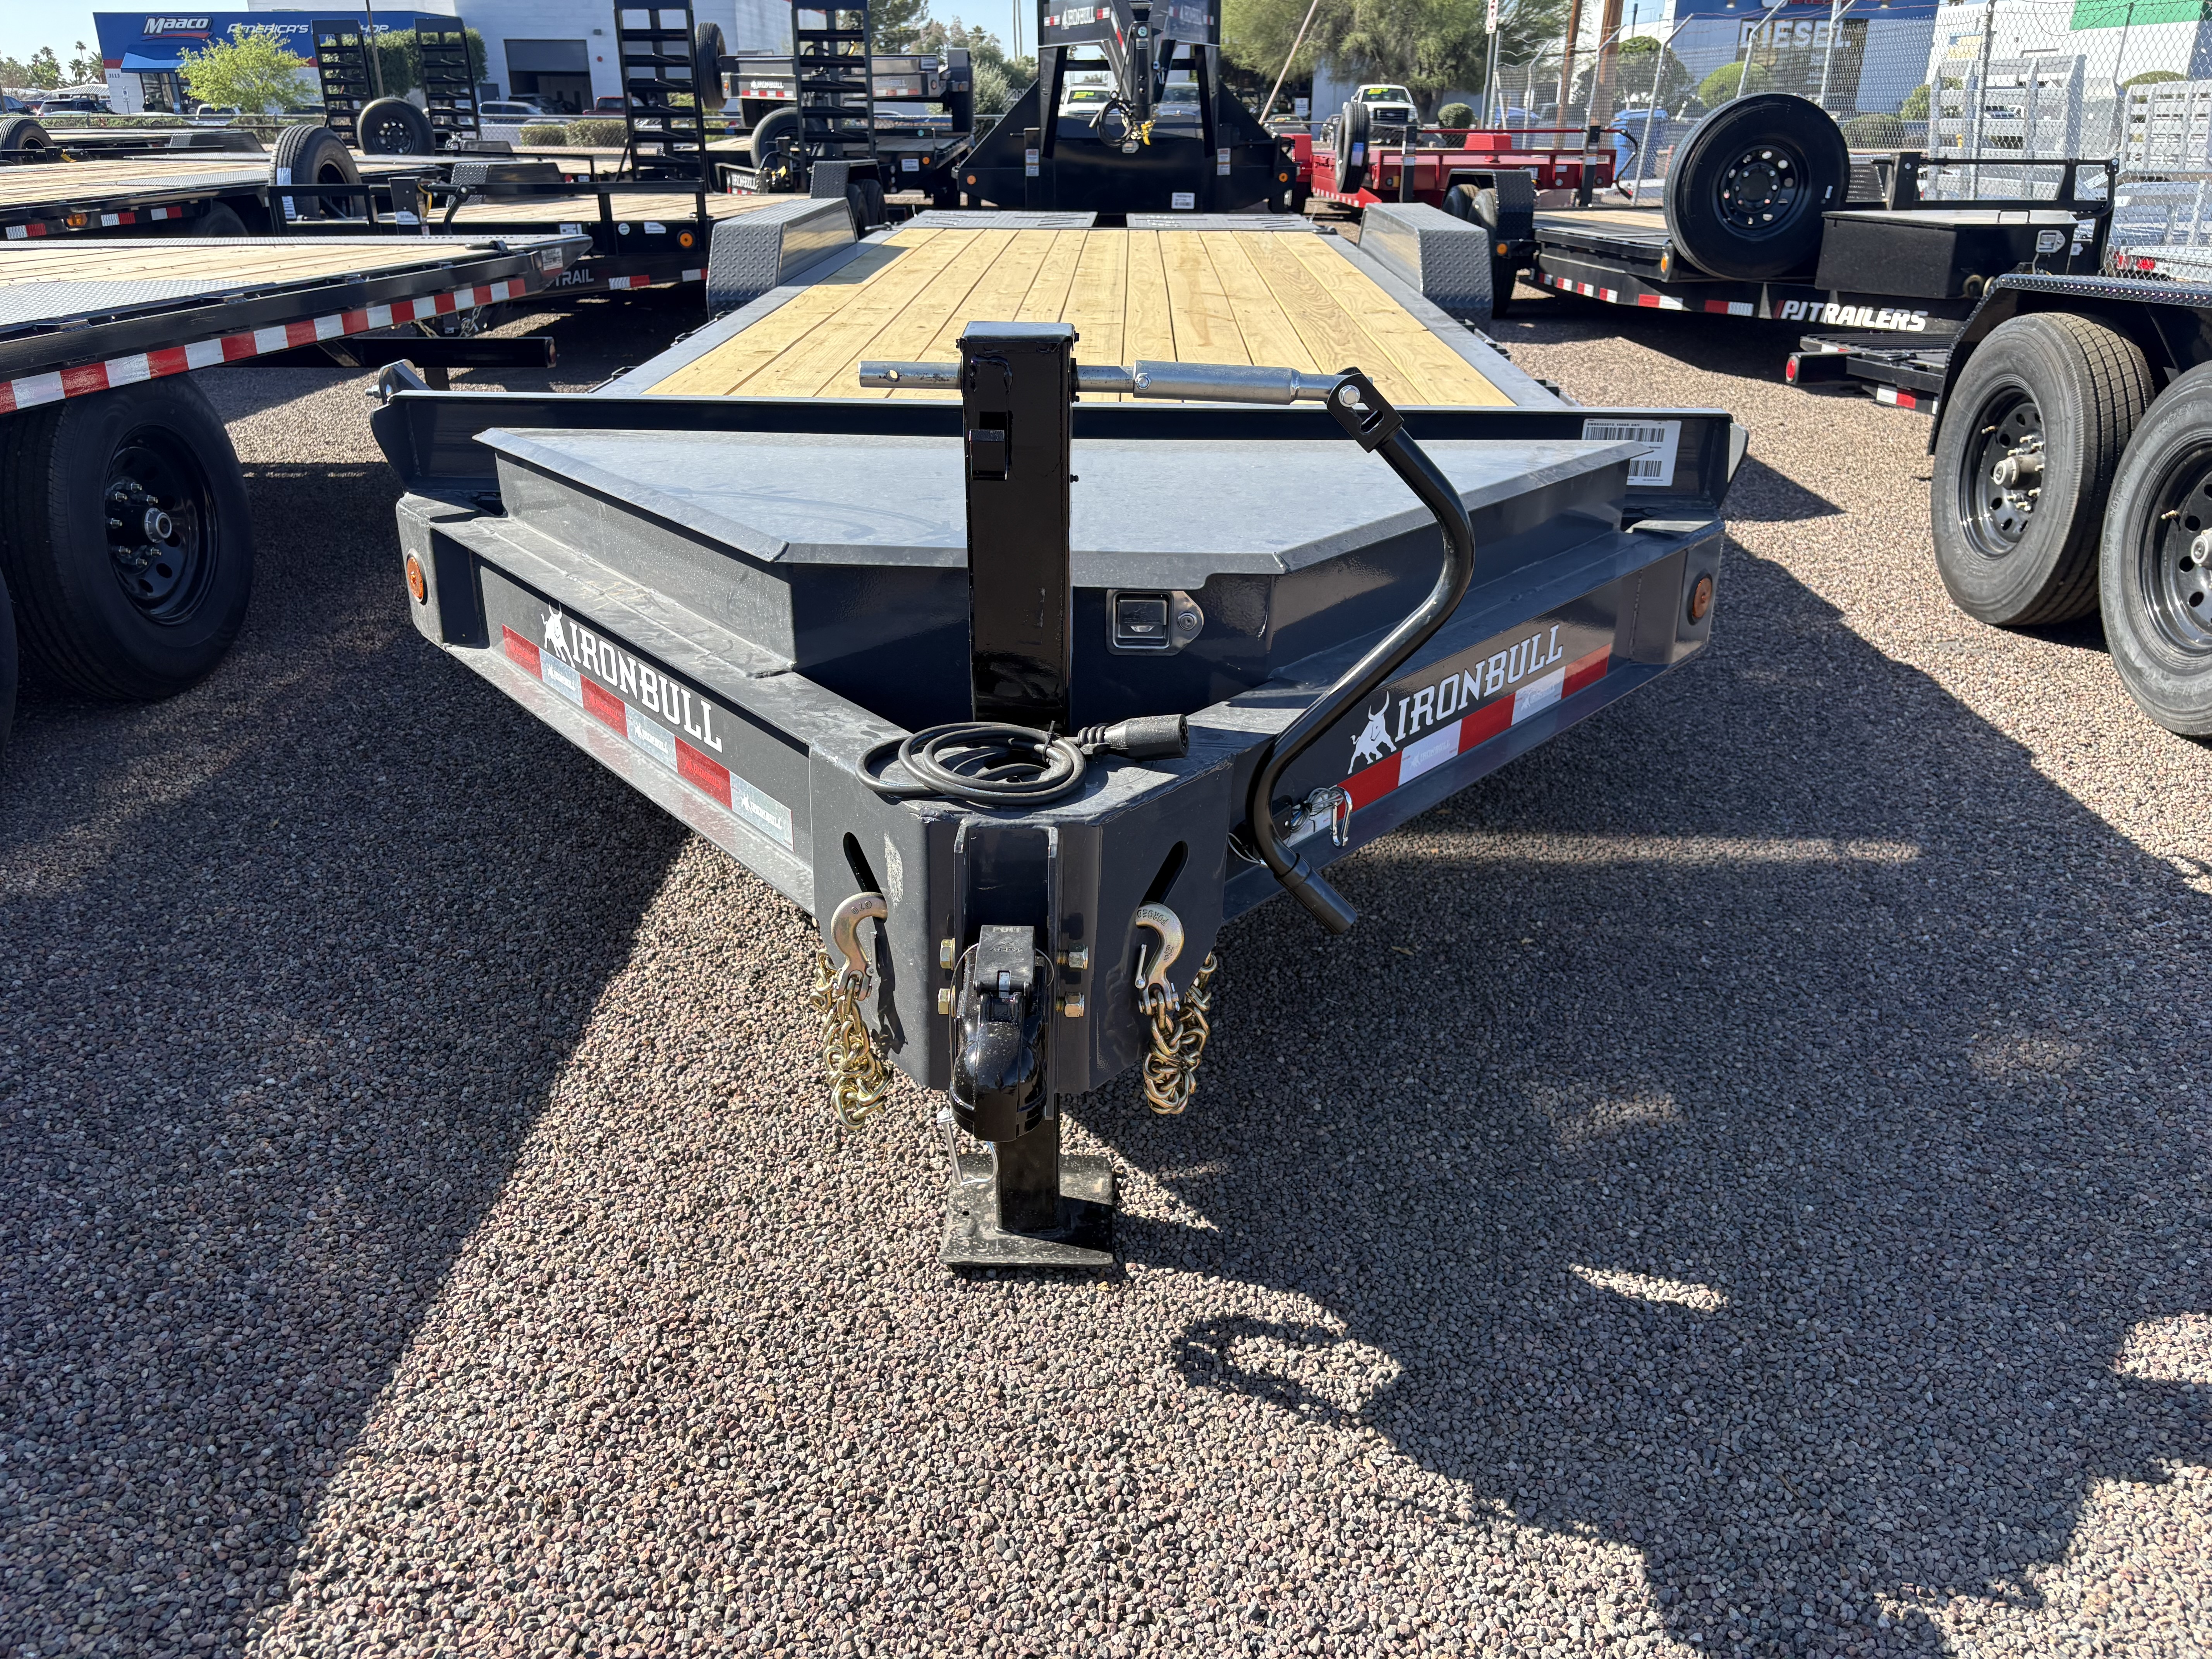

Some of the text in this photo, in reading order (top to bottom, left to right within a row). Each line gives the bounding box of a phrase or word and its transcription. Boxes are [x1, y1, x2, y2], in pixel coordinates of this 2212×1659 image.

[1739, 20, 1852, 48] DIESEL
[1809, 302, 1929, 332] TRAILERS
[569, 620, 723, 753] IRONBULL
[1395, 625, 1563, 742] IRONBULL
[1137, 909, 1169, 926] FORGED
